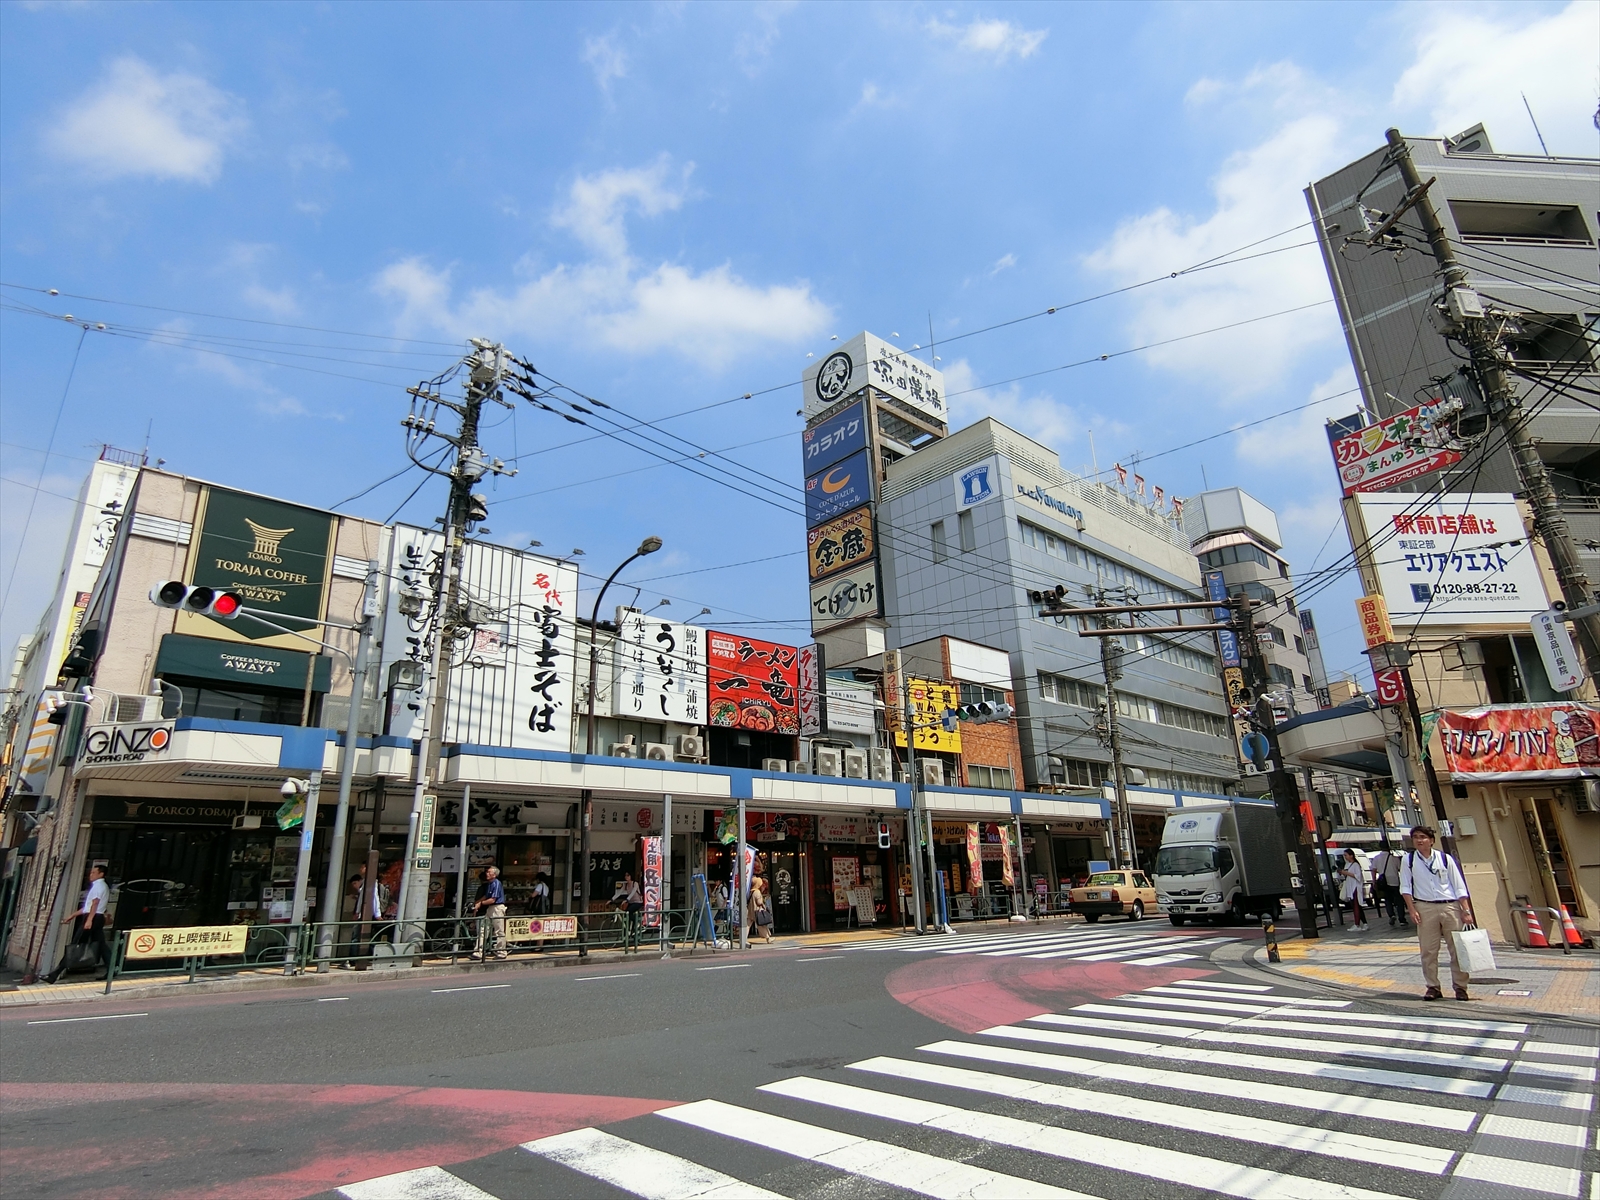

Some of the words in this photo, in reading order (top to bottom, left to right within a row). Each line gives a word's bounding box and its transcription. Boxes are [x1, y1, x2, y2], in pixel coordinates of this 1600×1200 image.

[872, 359, 942, 411] 塚田農場
[804, 430, 815, 443] 5F
[807, 419, 860, 459] カラオケ
[1337, 406, 1432, 464] カラオ
[962, 467, 988, 482] LAWSON
[806, 478, 818, 491] 4F
[965, 489, 990, 504] STATION
[1392, 514, 1498, 535] 駅前店舗は
[808, 531, 820, 545] 3F
[815, 527, 866, 567] 金の蔵
[1398, 539, 1436, 550] 東証2部
[248, 551, 283, 564] TOARCO
[1404, 552, 1508, 573] エリアクエスト
[215, 558, 261, 577] TORAJA
[265, 569, 308, 585] COFFEE
[236, 590, 281, 602] AWAYA
[532, 573, 564, 606] 名代
[1433, 583, 1517, 594] 0120-88-27-22
[813, 582, 875, 615] てけてけ
[1436, 594, 1521, 603] http://www.area-quest.com
[1361, 600, 1381, 637] 商品券
[737, 641, 797, 668] ラーメン
[1543, 623, 1569, 677] 東京品川病院
[225, 660, 275, 673] AWAYA
[528, 605, 563, 733] 富士そば
[656, 623, 675, 717] うなくし
[800, 649, 813, 713] ラーメン
[741, 697, 772, 707] ICHIRYU
[86, 753, 122, 764] SHOPPING
[123, 752, 145, 761] ROAD
[147, 805, 196, 816] TOARCO
[198, 807, 238, 818] TORAJA
[161, 931, 233, 945] 路上喫煙禁止
